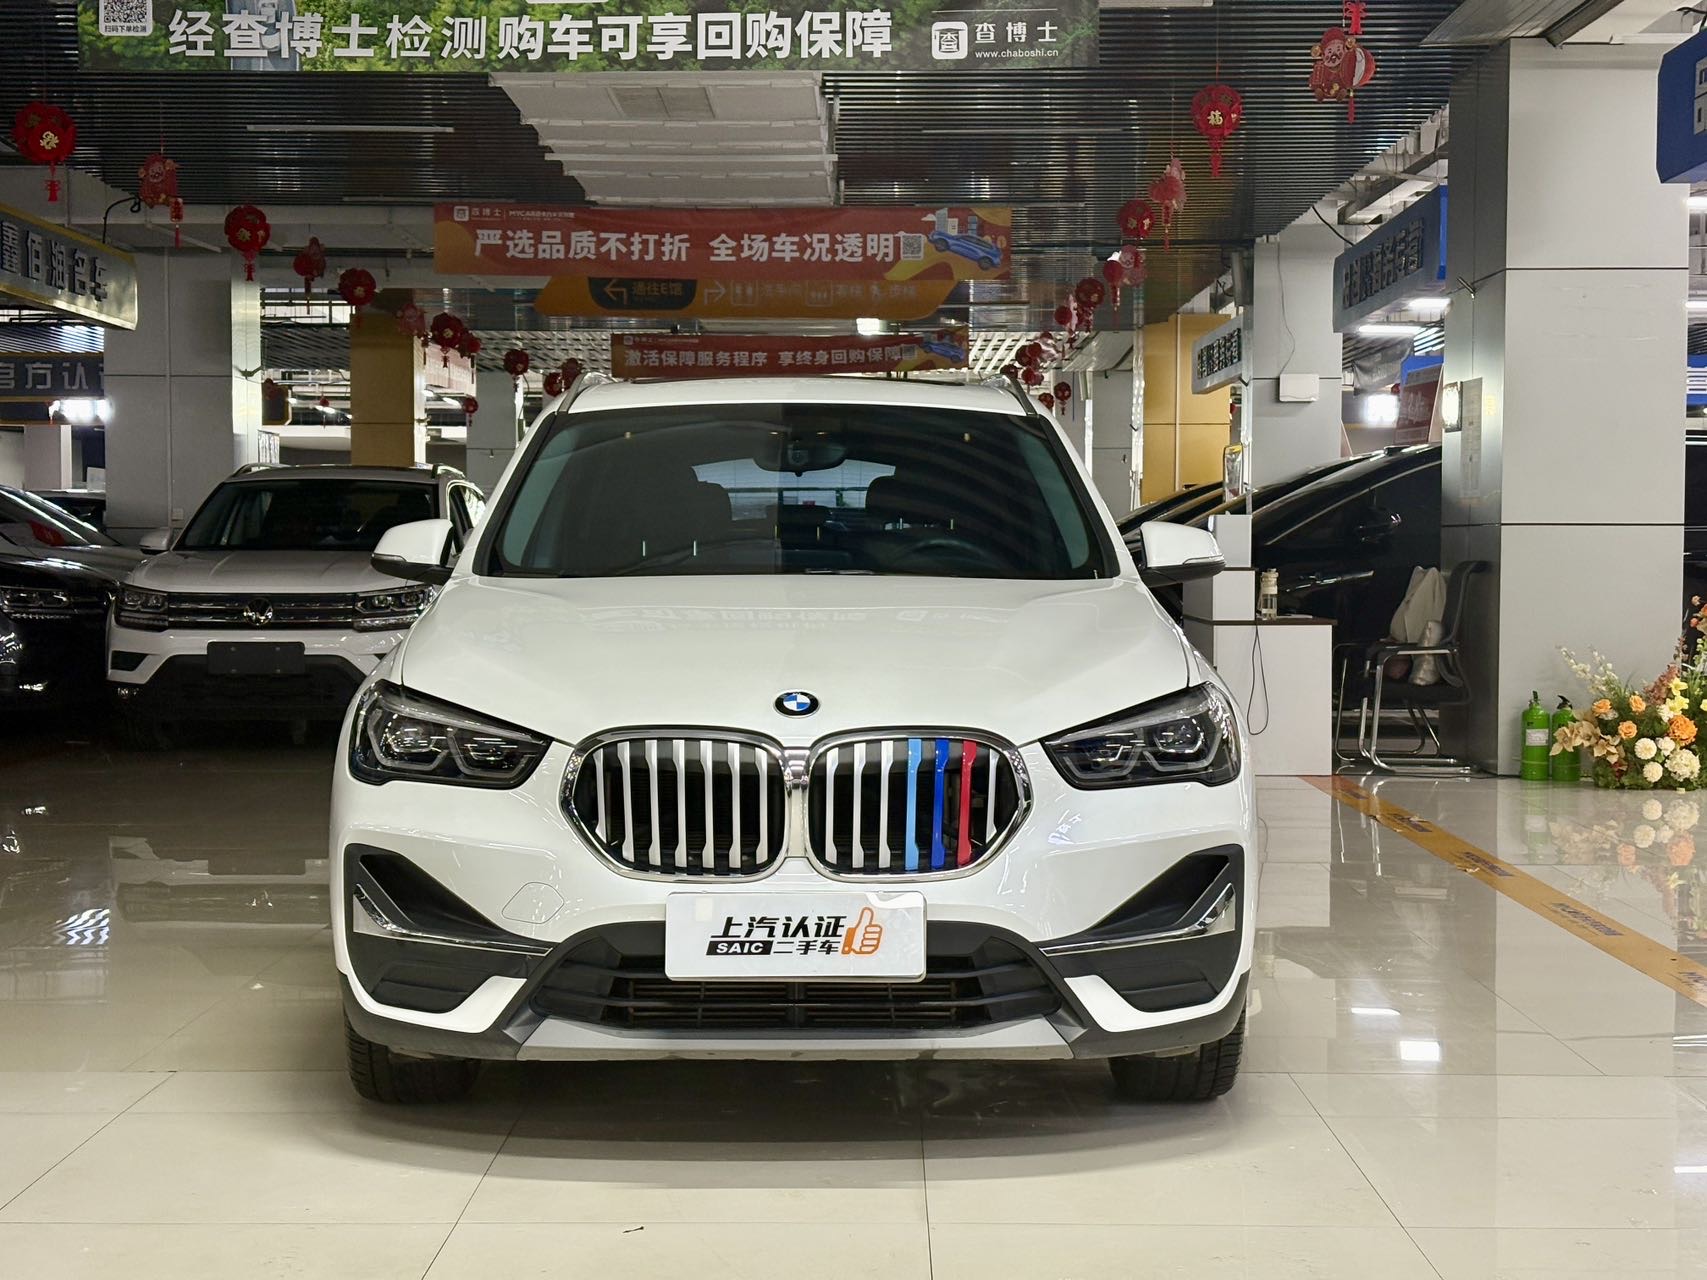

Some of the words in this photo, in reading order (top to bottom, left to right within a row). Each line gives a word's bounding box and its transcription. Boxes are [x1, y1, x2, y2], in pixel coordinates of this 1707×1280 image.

[104, 24, 147, 33] 扫码下单检测
[168, 9, 892, 60] 经查博士检测购车可享回购保障
[975, 21, 1058, 44] 查博士
[975, 48, 1059, 58] www.chaboshi.cn
[475, 229, 690, 261] 严选品质不打折
[709, 233, 894, 262] 全场车况透明
[624, 349, 768, 367] 激活保障服务程序
[778, 344, 901, 366] 享终身回购保障
[0, 362, 104, 390] 官方认
[710, 915, 847, 938] 上汽认证
[716, 942, 764, 953] SAIC
[773, 940, 840, 955] 二手车
